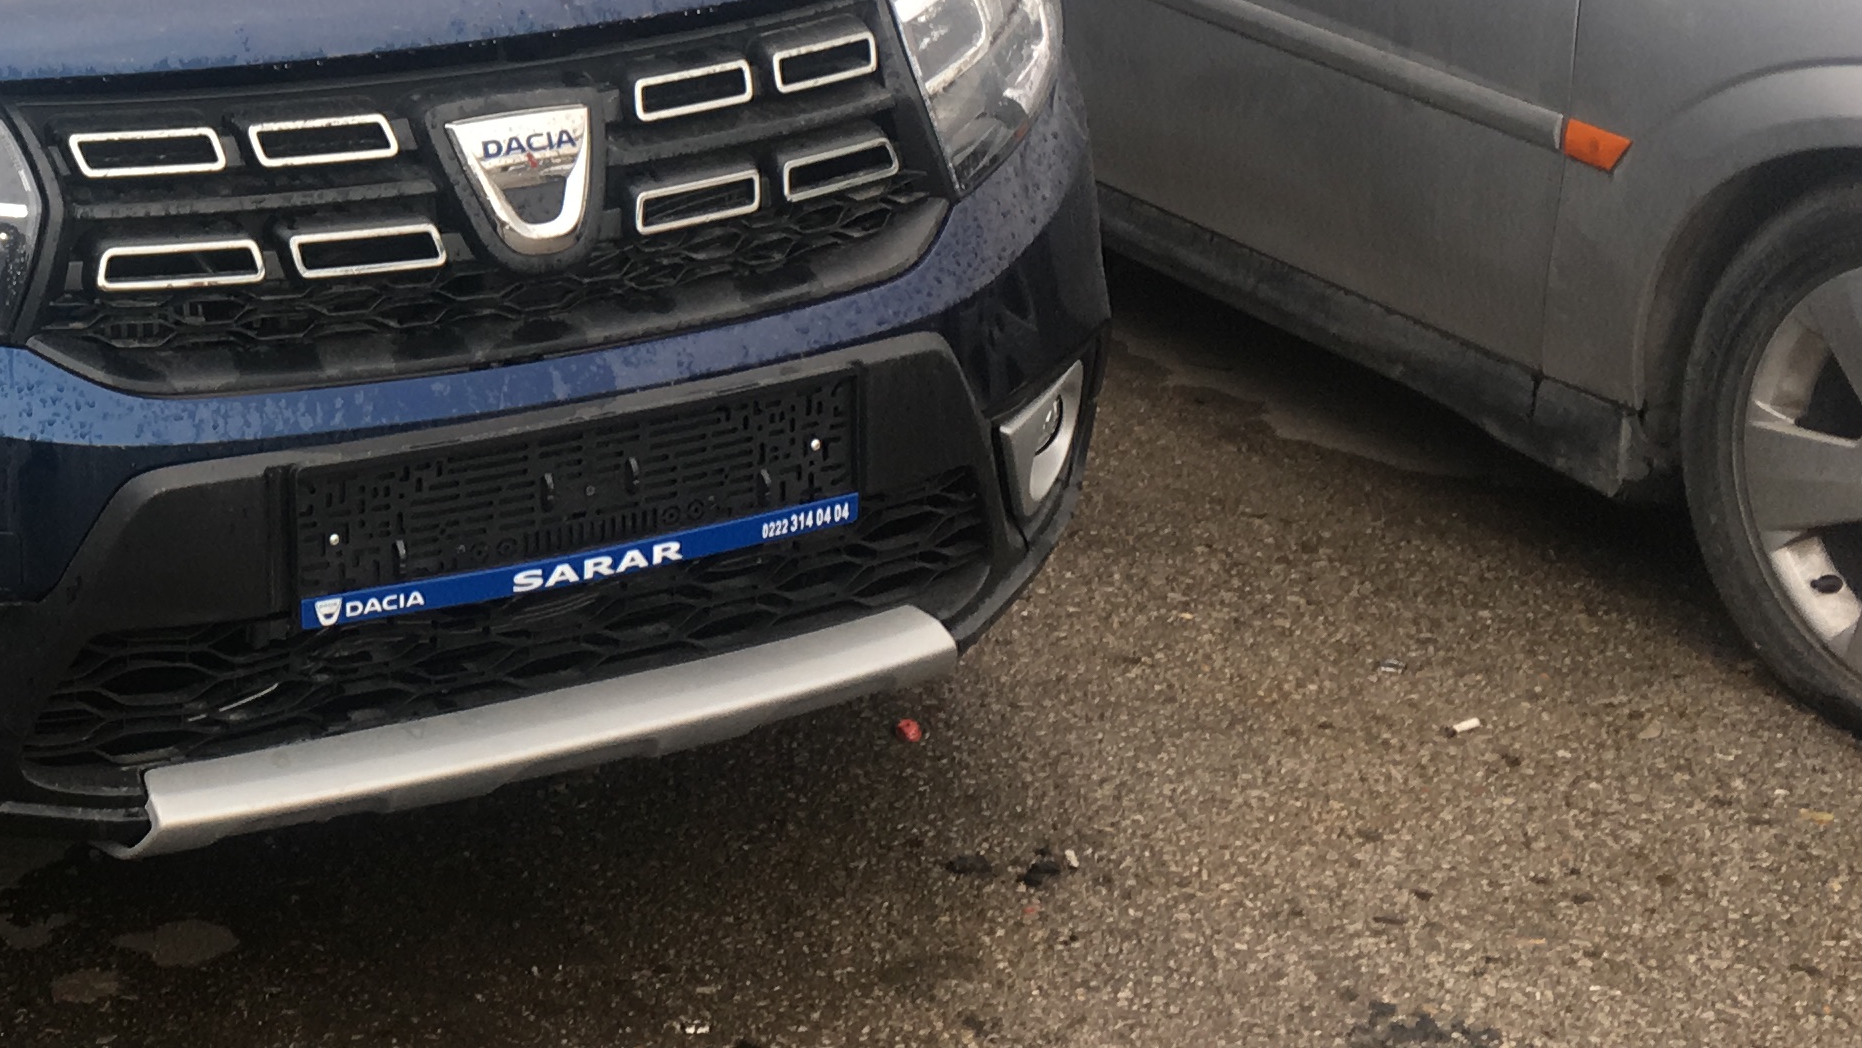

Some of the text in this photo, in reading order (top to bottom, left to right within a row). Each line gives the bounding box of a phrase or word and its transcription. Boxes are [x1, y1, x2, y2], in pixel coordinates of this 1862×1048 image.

[481, 129, 577, 159] DACIA
[762, 501, 850, 539] 0222 314 04 04
[512, 541, 684, 593] SARAR
[345, 591, 425, 618] DACIA
